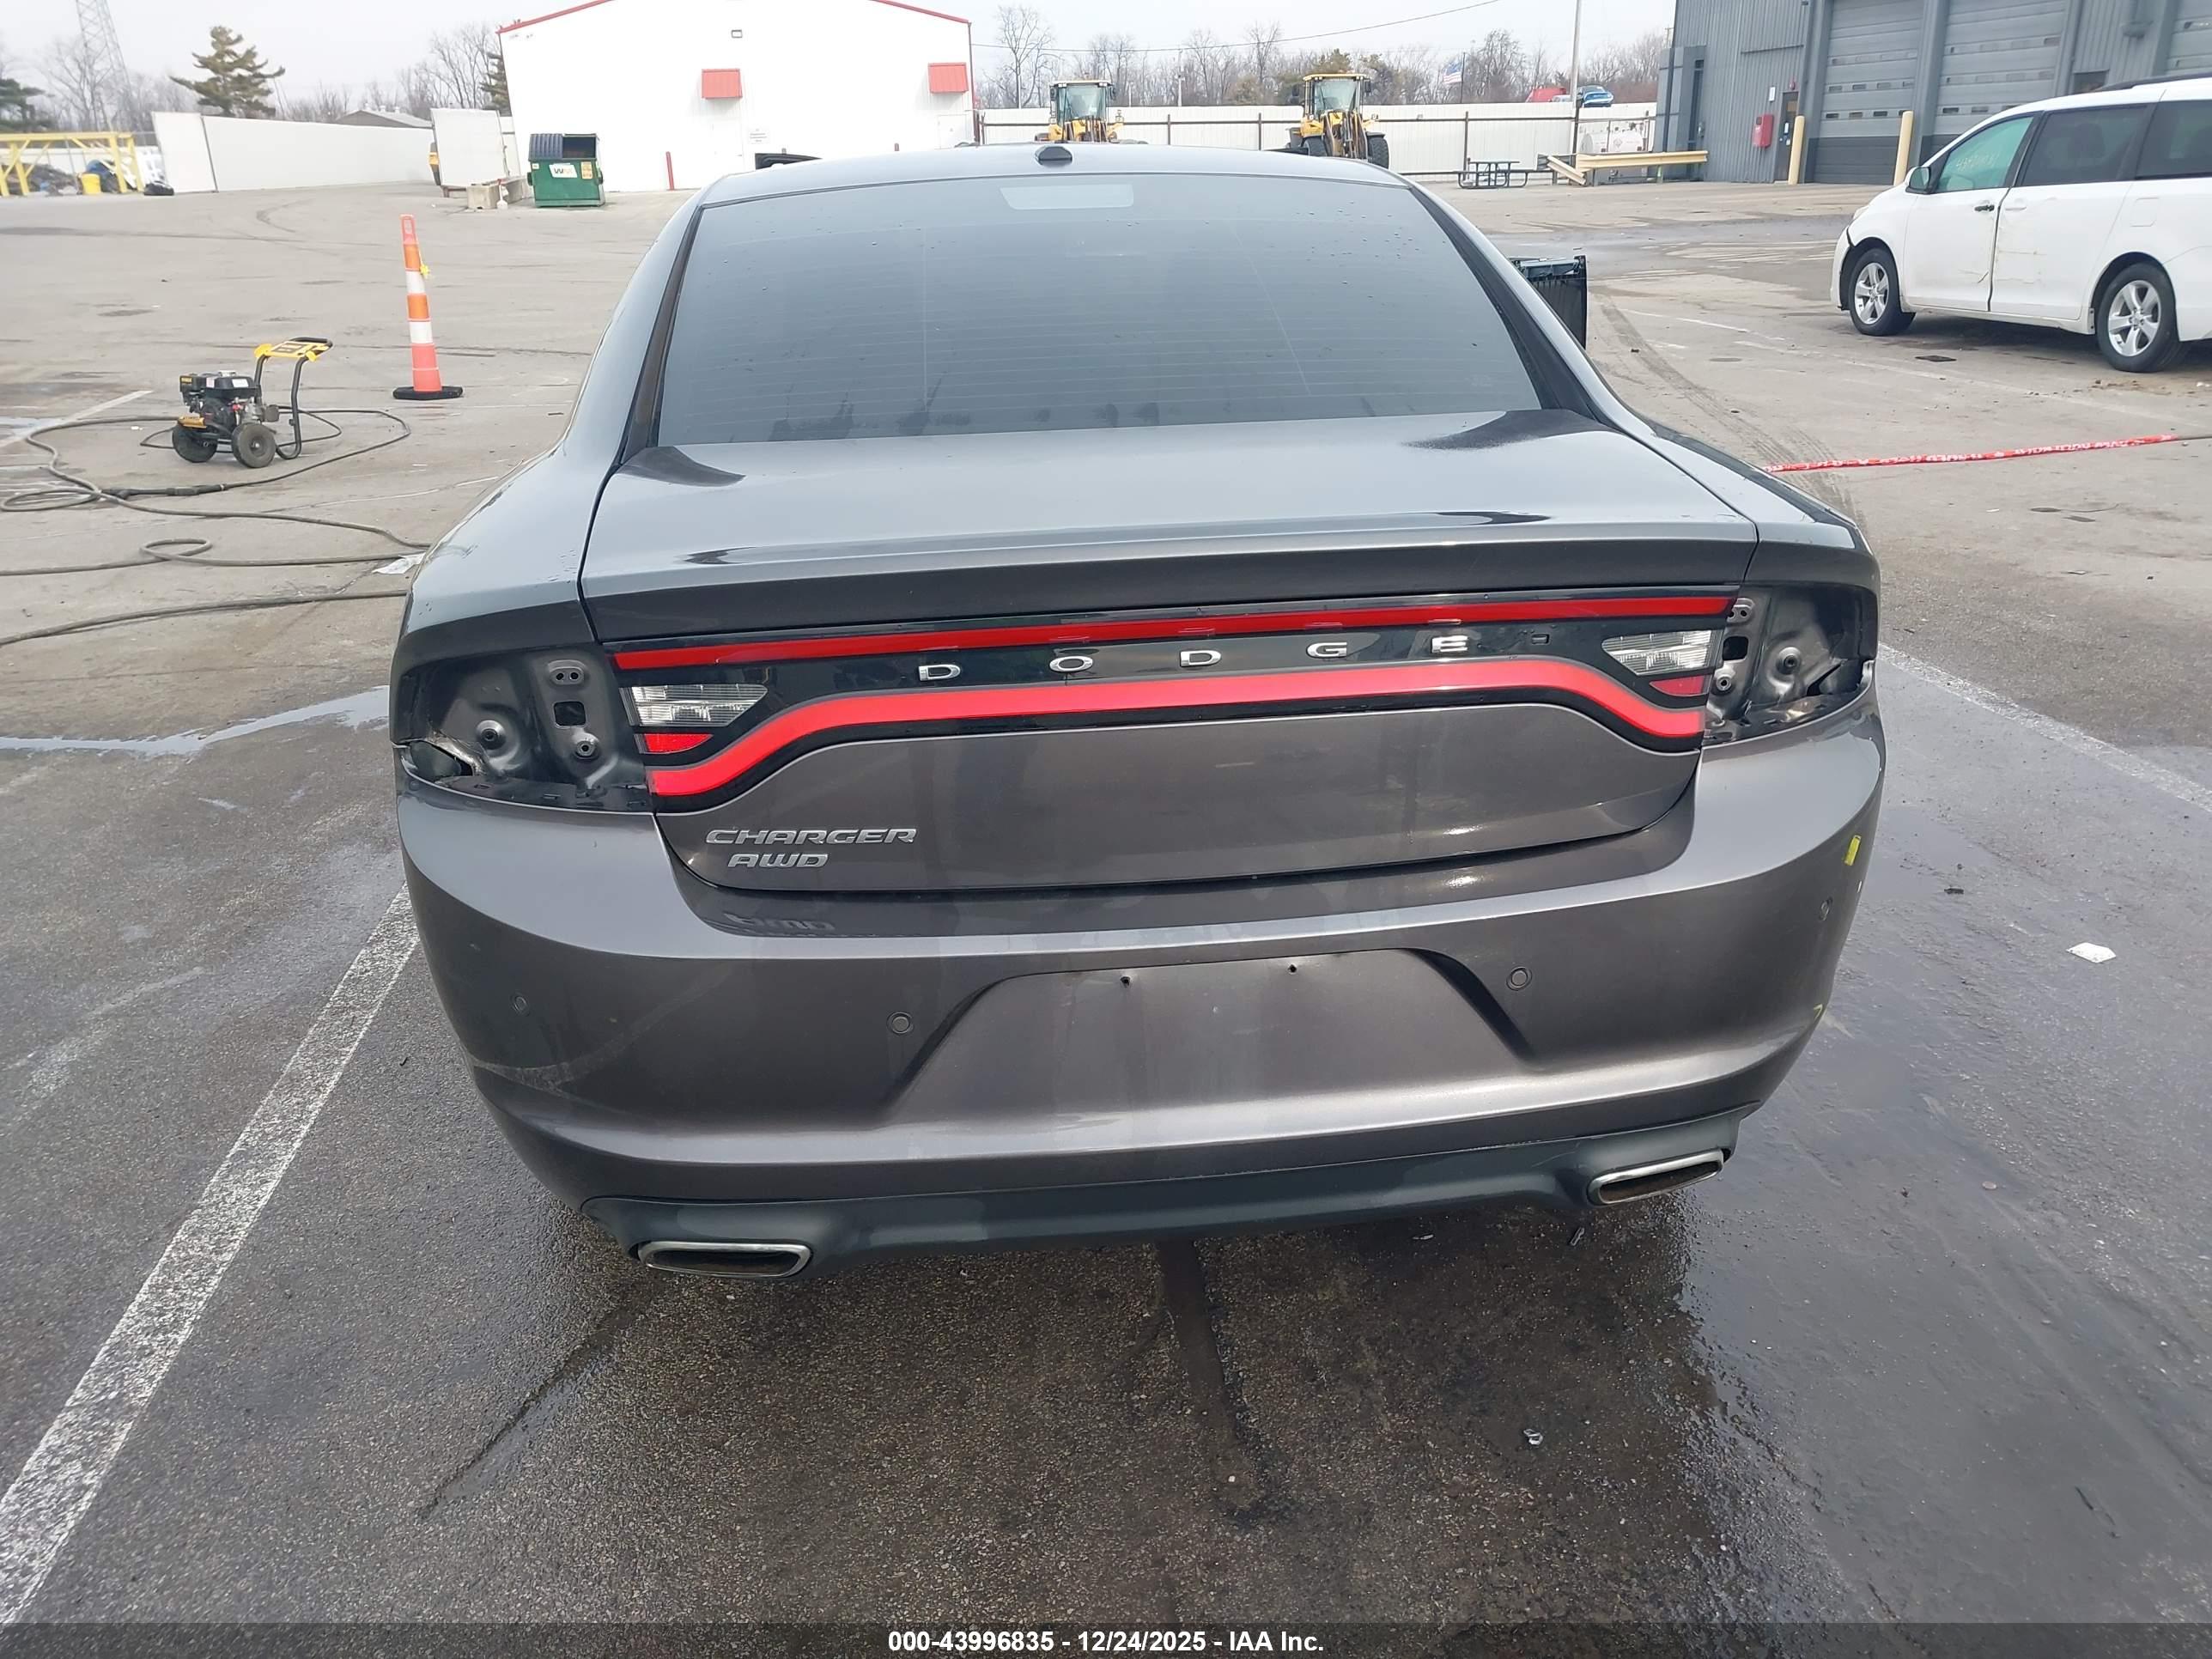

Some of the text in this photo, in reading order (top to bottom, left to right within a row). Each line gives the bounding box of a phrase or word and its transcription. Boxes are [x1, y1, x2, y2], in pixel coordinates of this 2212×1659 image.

[917, 635, 1469, 682] DODGE
[705, 828, 917, 845] CHARGER
[727, 853, 829, 868] AWD
